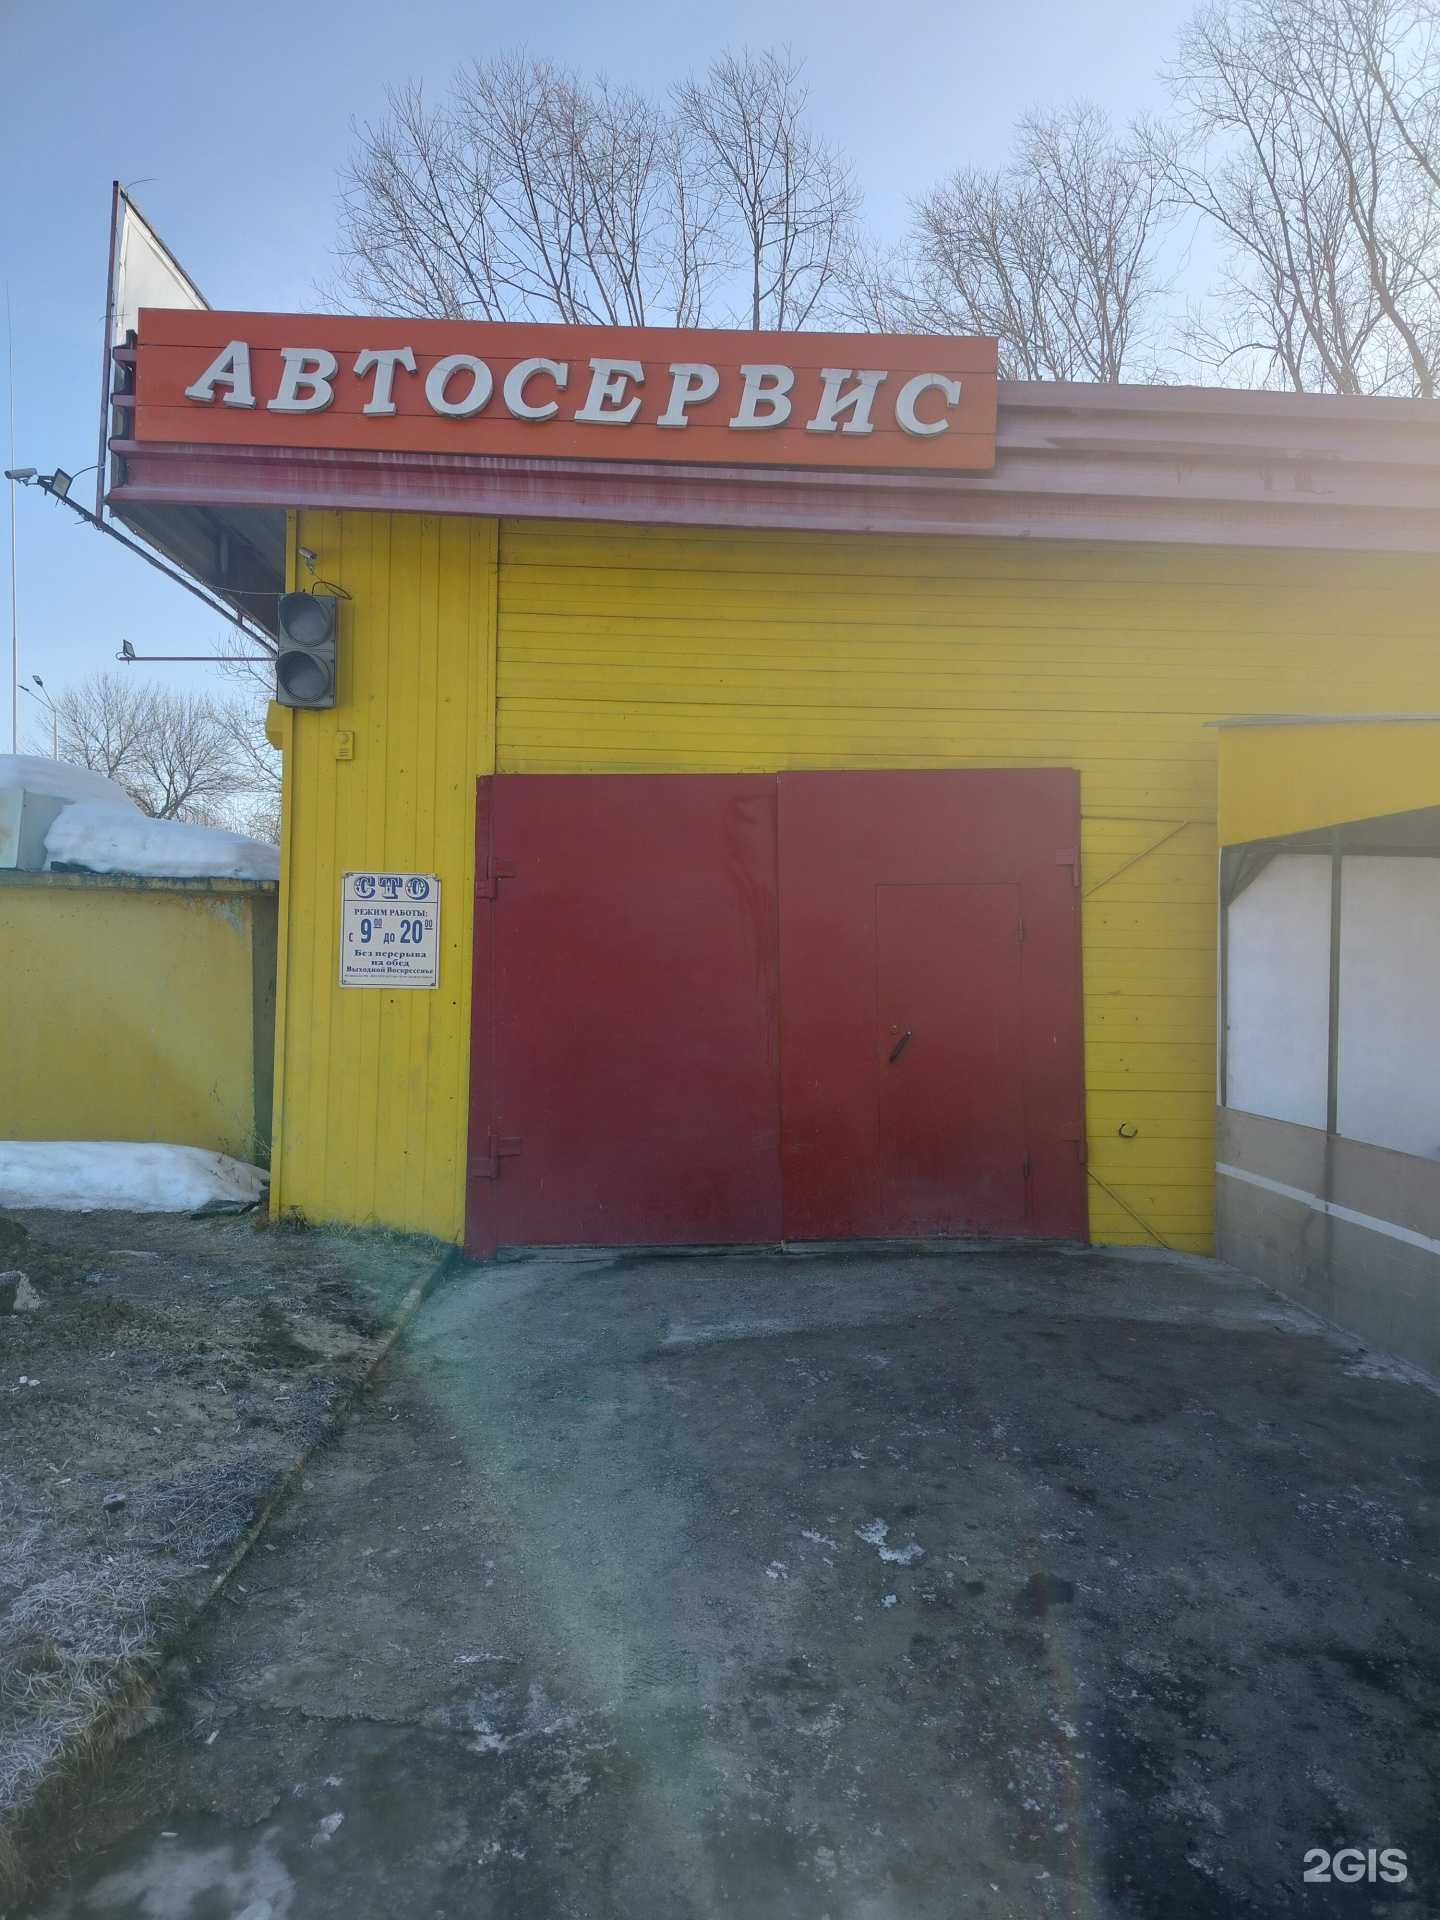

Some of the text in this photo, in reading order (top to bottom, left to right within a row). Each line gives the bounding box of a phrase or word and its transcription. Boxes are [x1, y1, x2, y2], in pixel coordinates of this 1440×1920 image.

[185, 340, 962, 437] АВТОСЕРВИС
[354, 876, 430, 900] СТО
[375, 951, 427, 959] перерыва
[386, 959, 410, 967] обед
